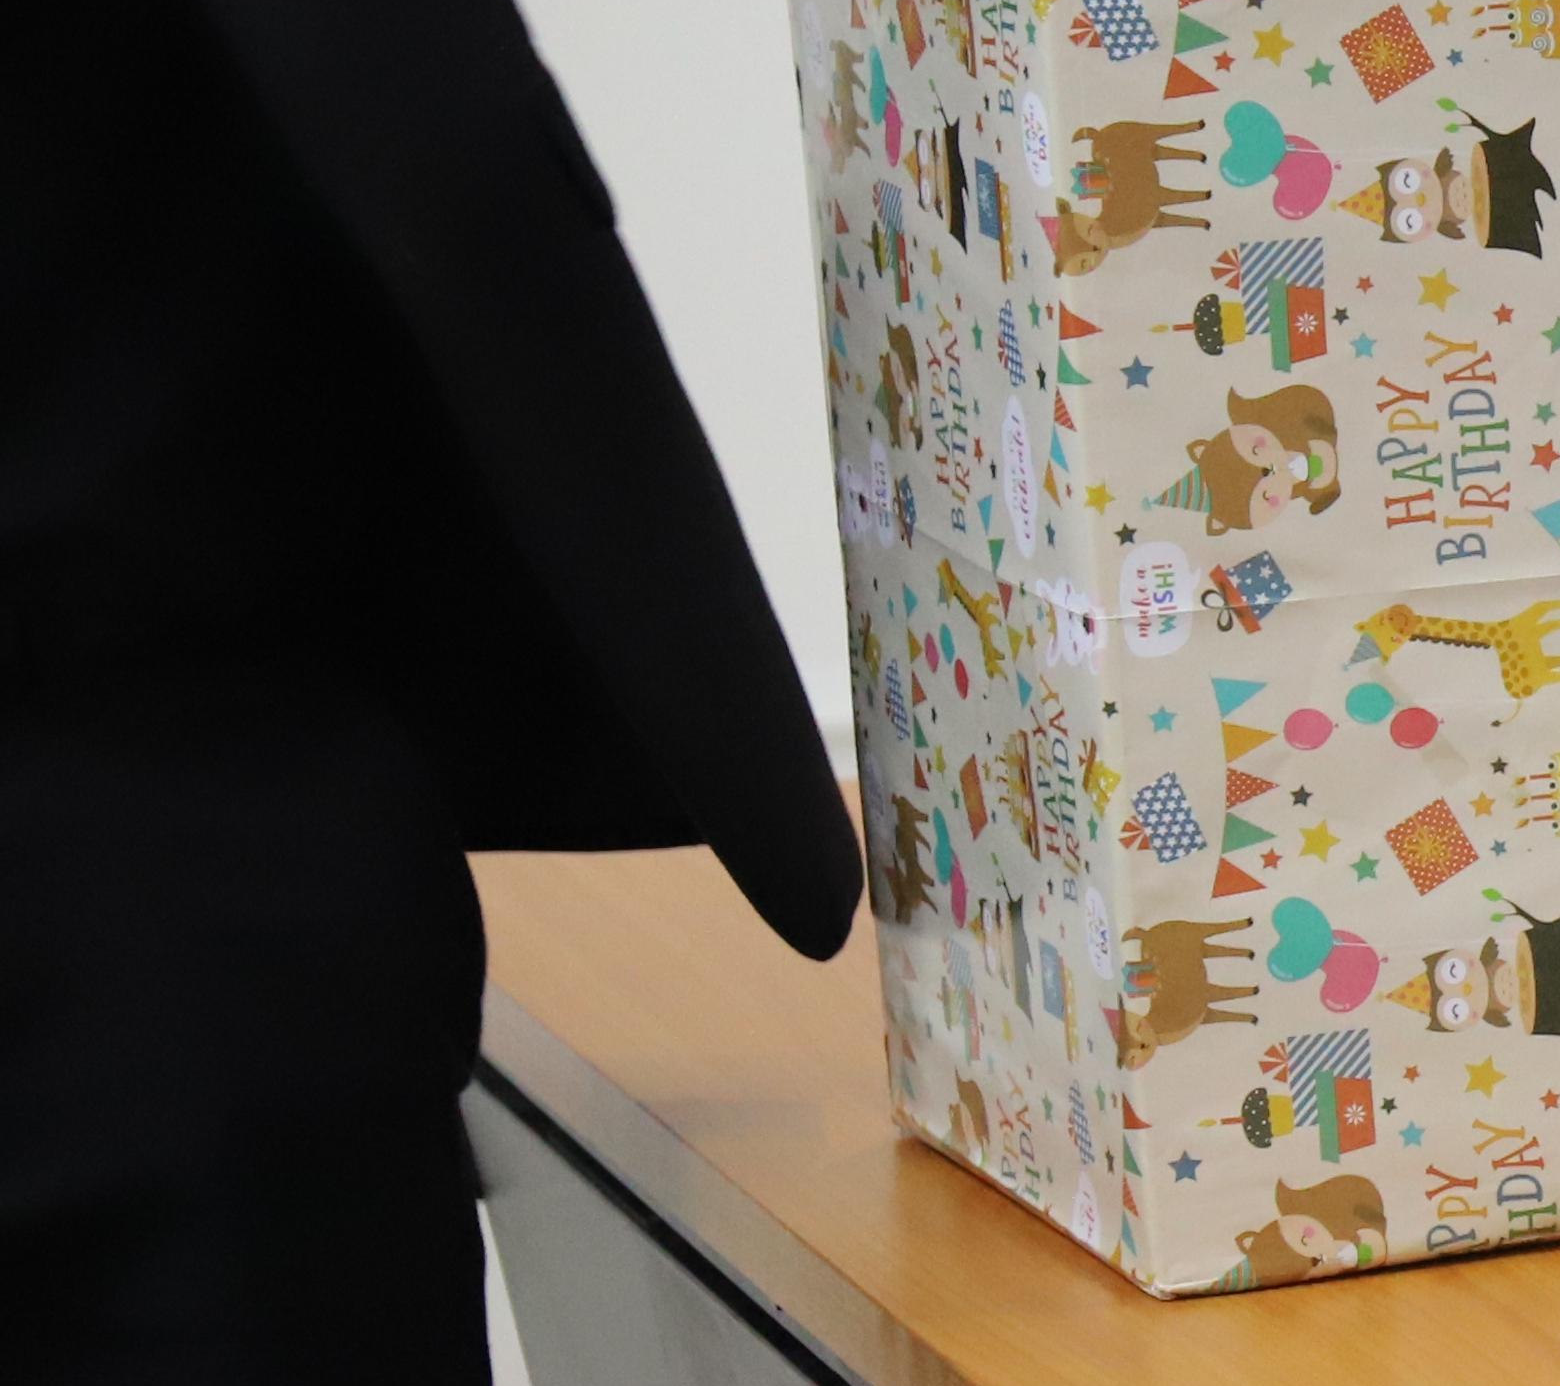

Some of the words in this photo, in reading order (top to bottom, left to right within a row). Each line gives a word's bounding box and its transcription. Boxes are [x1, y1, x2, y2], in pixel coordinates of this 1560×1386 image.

[925, 337, 951, 486] HAPPY
[936, 303, 970, 534] BIRTHDAY
[1376, 375, 1444, 529] HAPPY
[1424, 330, 1512, 566] BIRTHDAY
[1151, 563, 1178, 635] WISH!
[1425, 1164, 1489, 1252] PPY
[1472, 1118, 1558, 1241] HDAY
